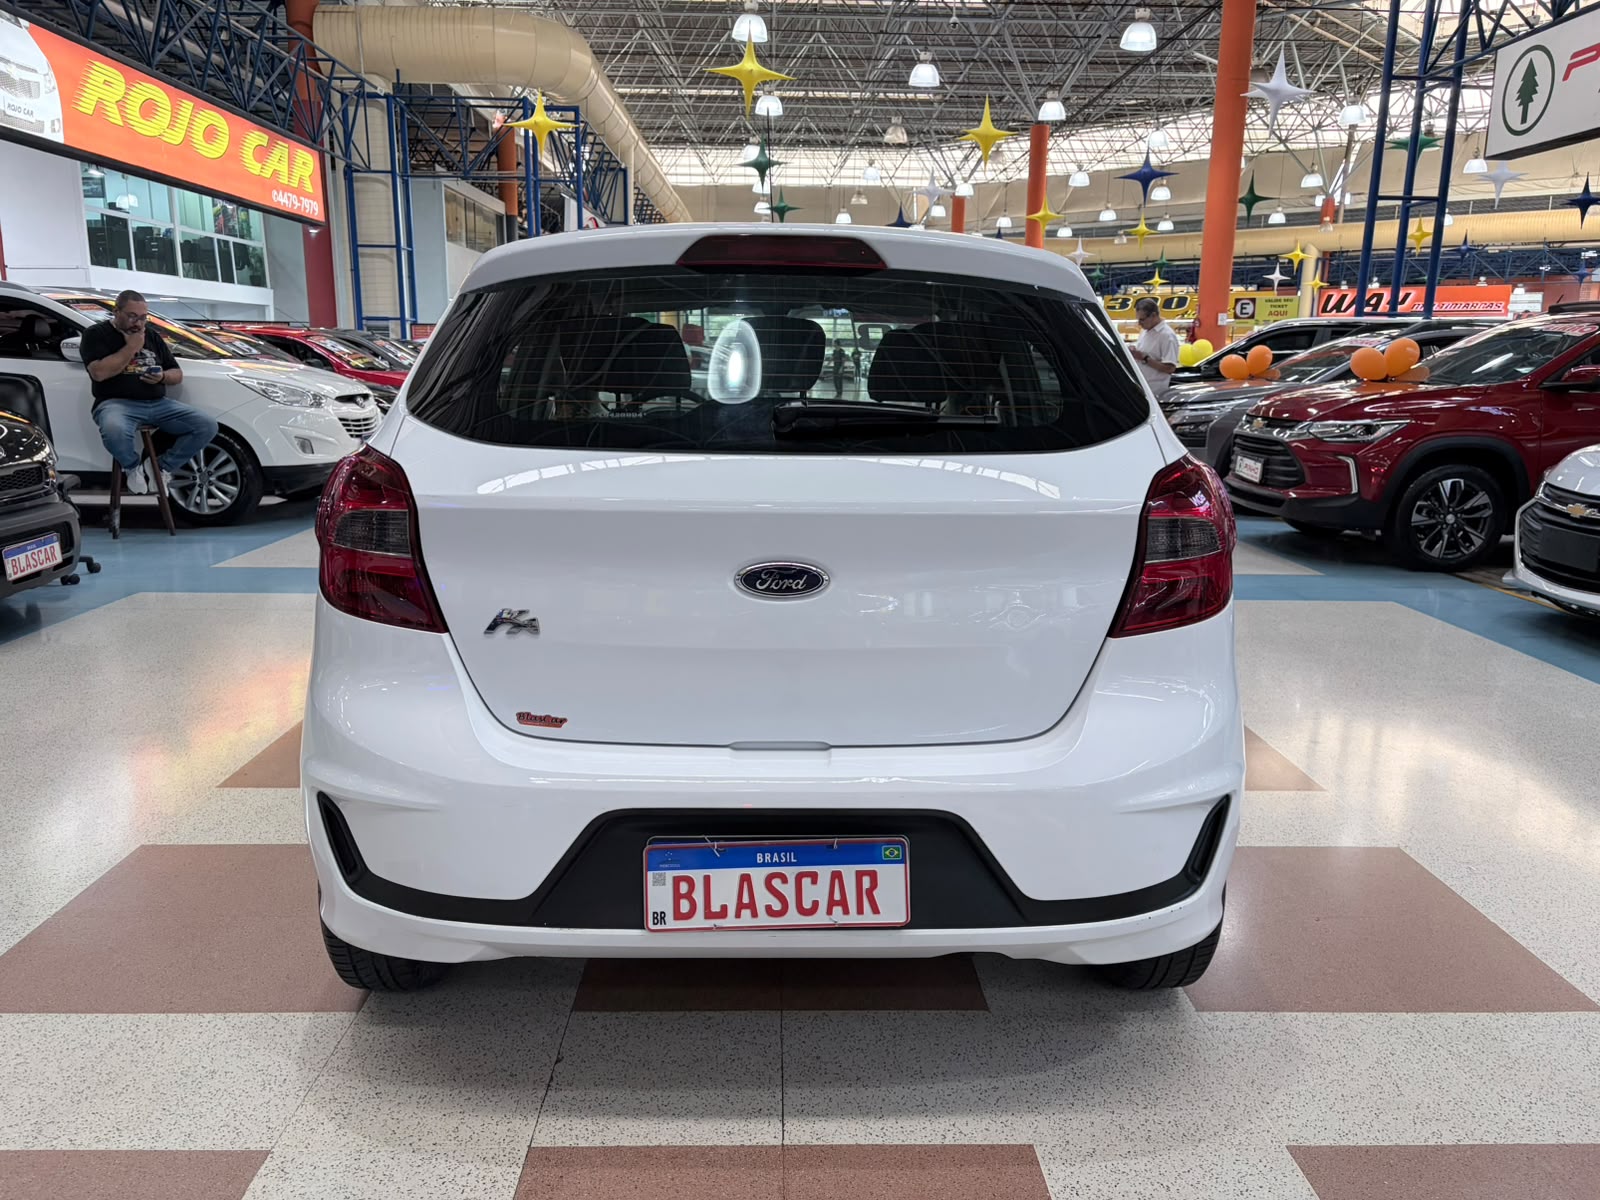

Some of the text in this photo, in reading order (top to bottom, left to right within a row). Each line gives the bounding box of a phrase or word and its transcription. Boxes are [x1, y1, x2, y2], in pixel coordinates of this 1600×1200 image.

[72, 58, 315, 194] ROJO CAR
[278, 190, 319, 217] 4479-7979
[1240, 302, 1250, 316] E
[1410, 302, 1505, 311] MLTIMARCAS
[10, 545, 58, 577] BLASCAR
[755, 569, 808, 590] Ford
[756, 851, 798, 864] BRASIL
[671, 869, 882, 922] BLASCAR
[652, 911, 667, 926] BR
